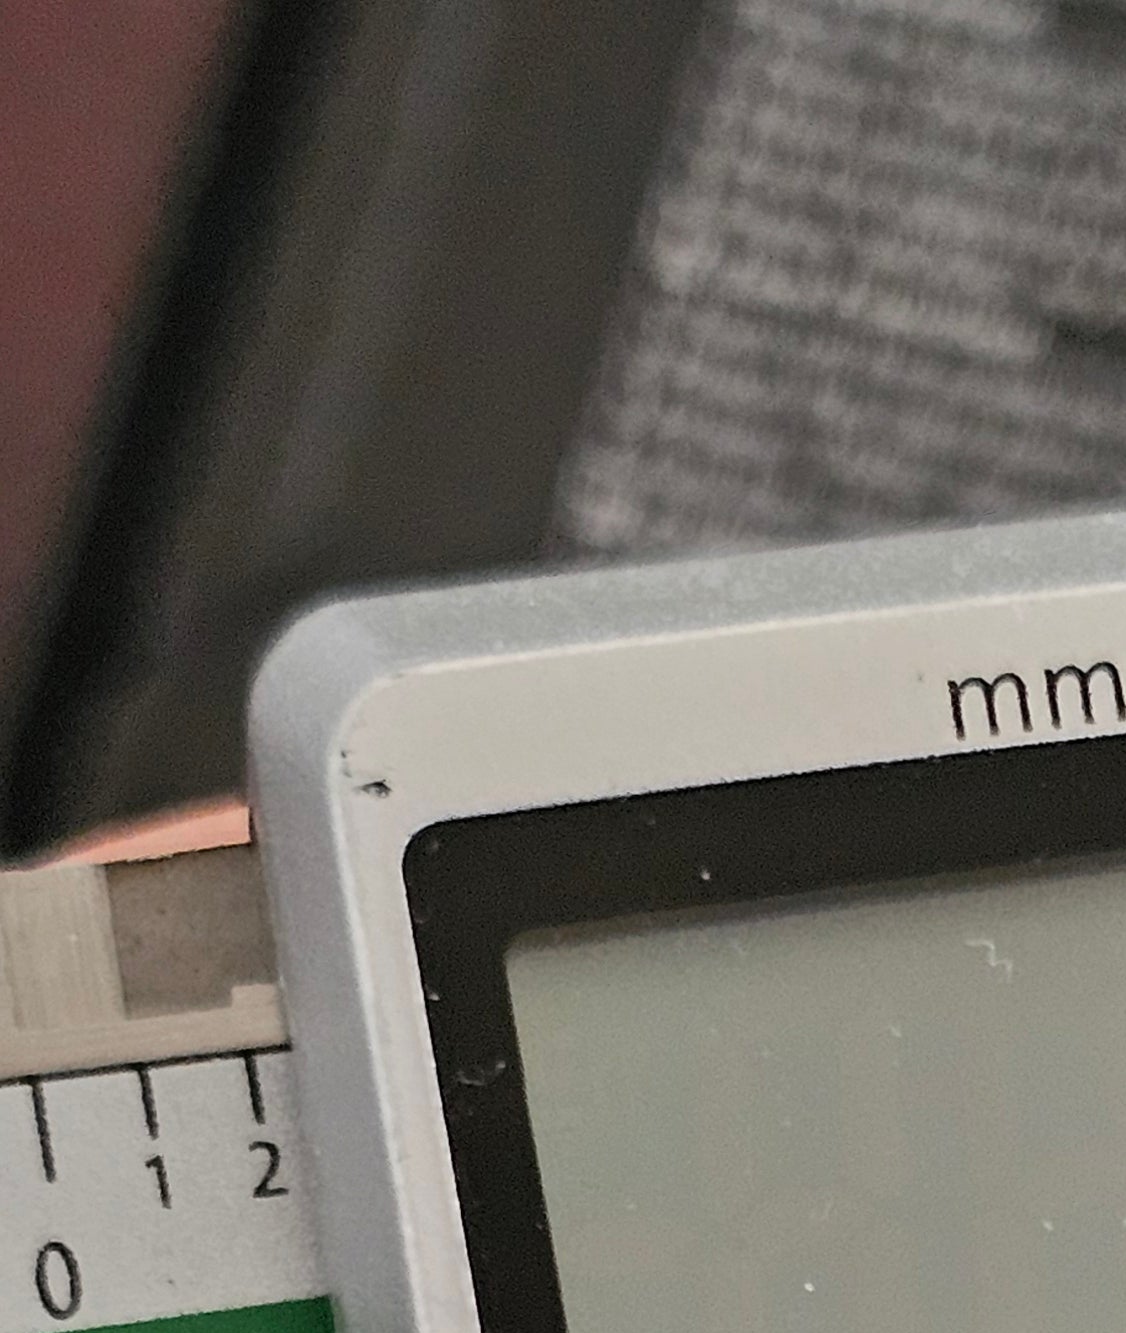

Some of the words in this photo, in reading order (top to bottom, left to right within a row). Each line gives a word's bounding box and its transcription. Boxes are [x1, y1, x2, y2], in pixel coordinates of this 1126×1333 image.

[145, 1155, 171, 1209] 1
[248, 1141, 288, 1198] 2
[35, 1241, 82, 1320] 0
